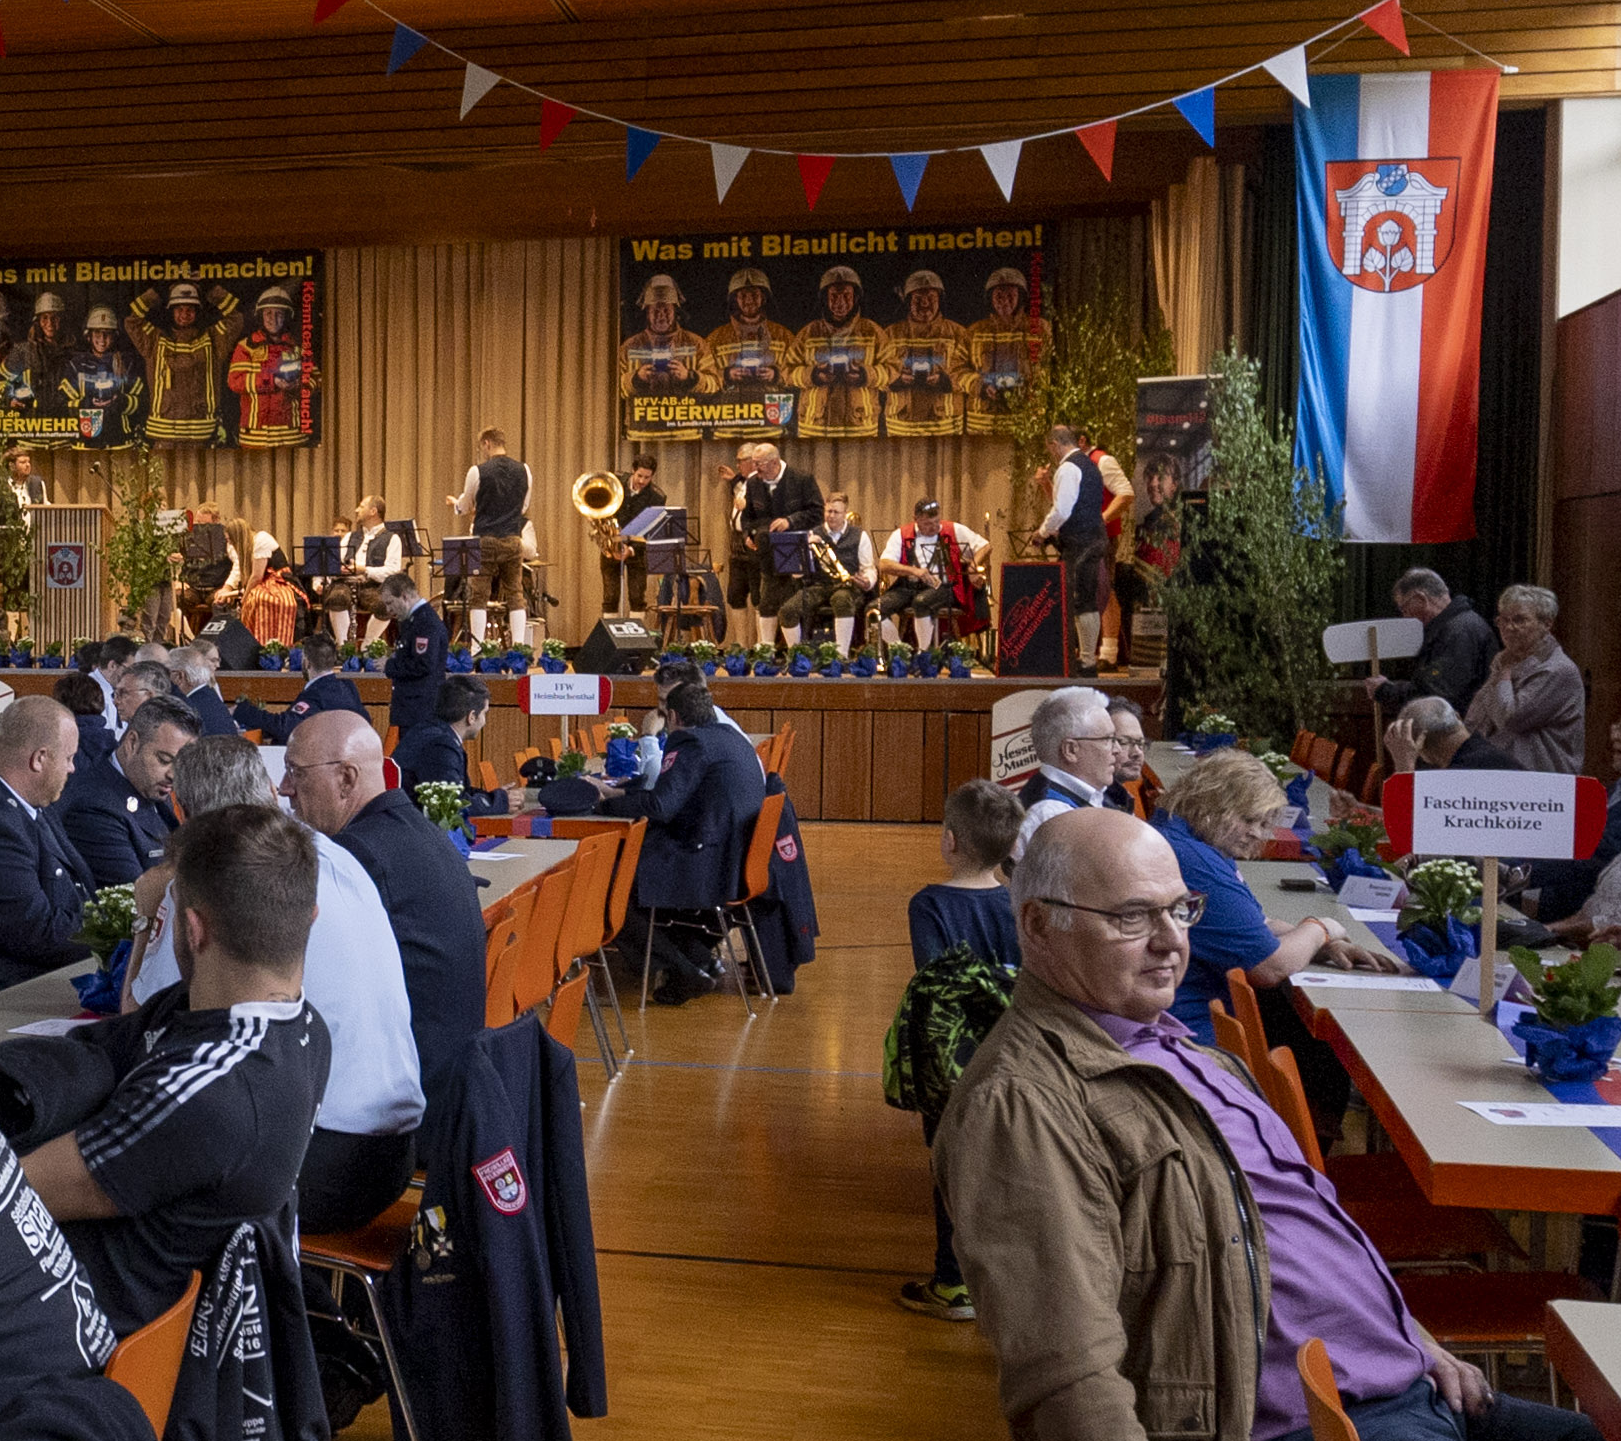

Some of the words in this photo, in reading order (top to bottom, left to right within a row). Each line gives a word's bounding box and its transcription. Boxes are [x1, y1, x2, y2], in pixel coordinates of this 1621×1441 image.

[632, 238, 693, 262] Was
[703, 236, 752, 259] mit
[762, 230, 899, 257] Blaulicht
[908, 224, 1044, 251] machen!
[26, 263, 67, 284] mit
[76, 260, 191, 282] Blaulicht
[199, 256, 314, 280] machen!
[300, 388, 314, 434] auch!
[634, 396, 697, 407] KFV-AB.de
[634, 403, 765, 422] FEUERWEHR
[1423, 795, 1565, 814] Faschingsverein
[1444, 814, 1542, 831] Krachköize
